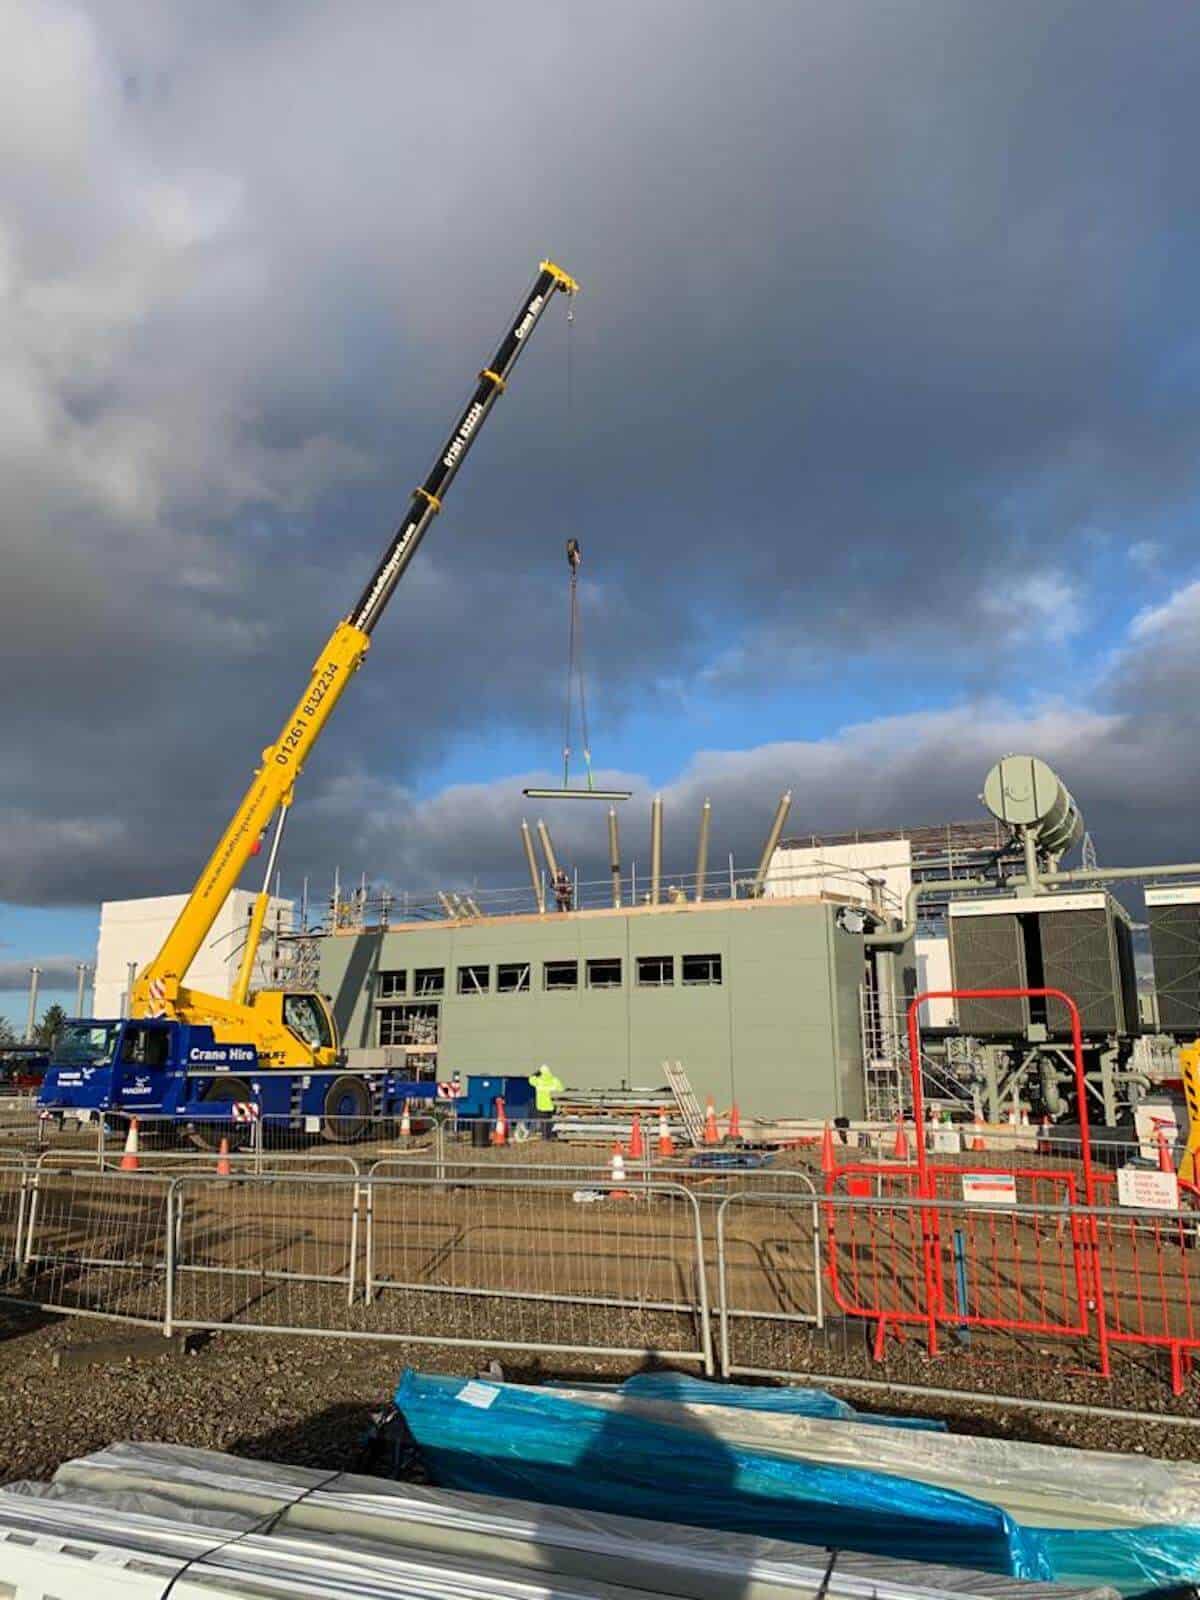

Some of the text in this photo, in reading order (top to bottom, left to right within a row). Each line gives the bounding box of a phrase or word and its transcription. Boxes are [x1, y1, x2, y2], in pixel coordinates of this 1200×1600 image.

[275, 662, 339, 766] 01261 832234
[189, 1047, 255, 1061] Crane Hire
